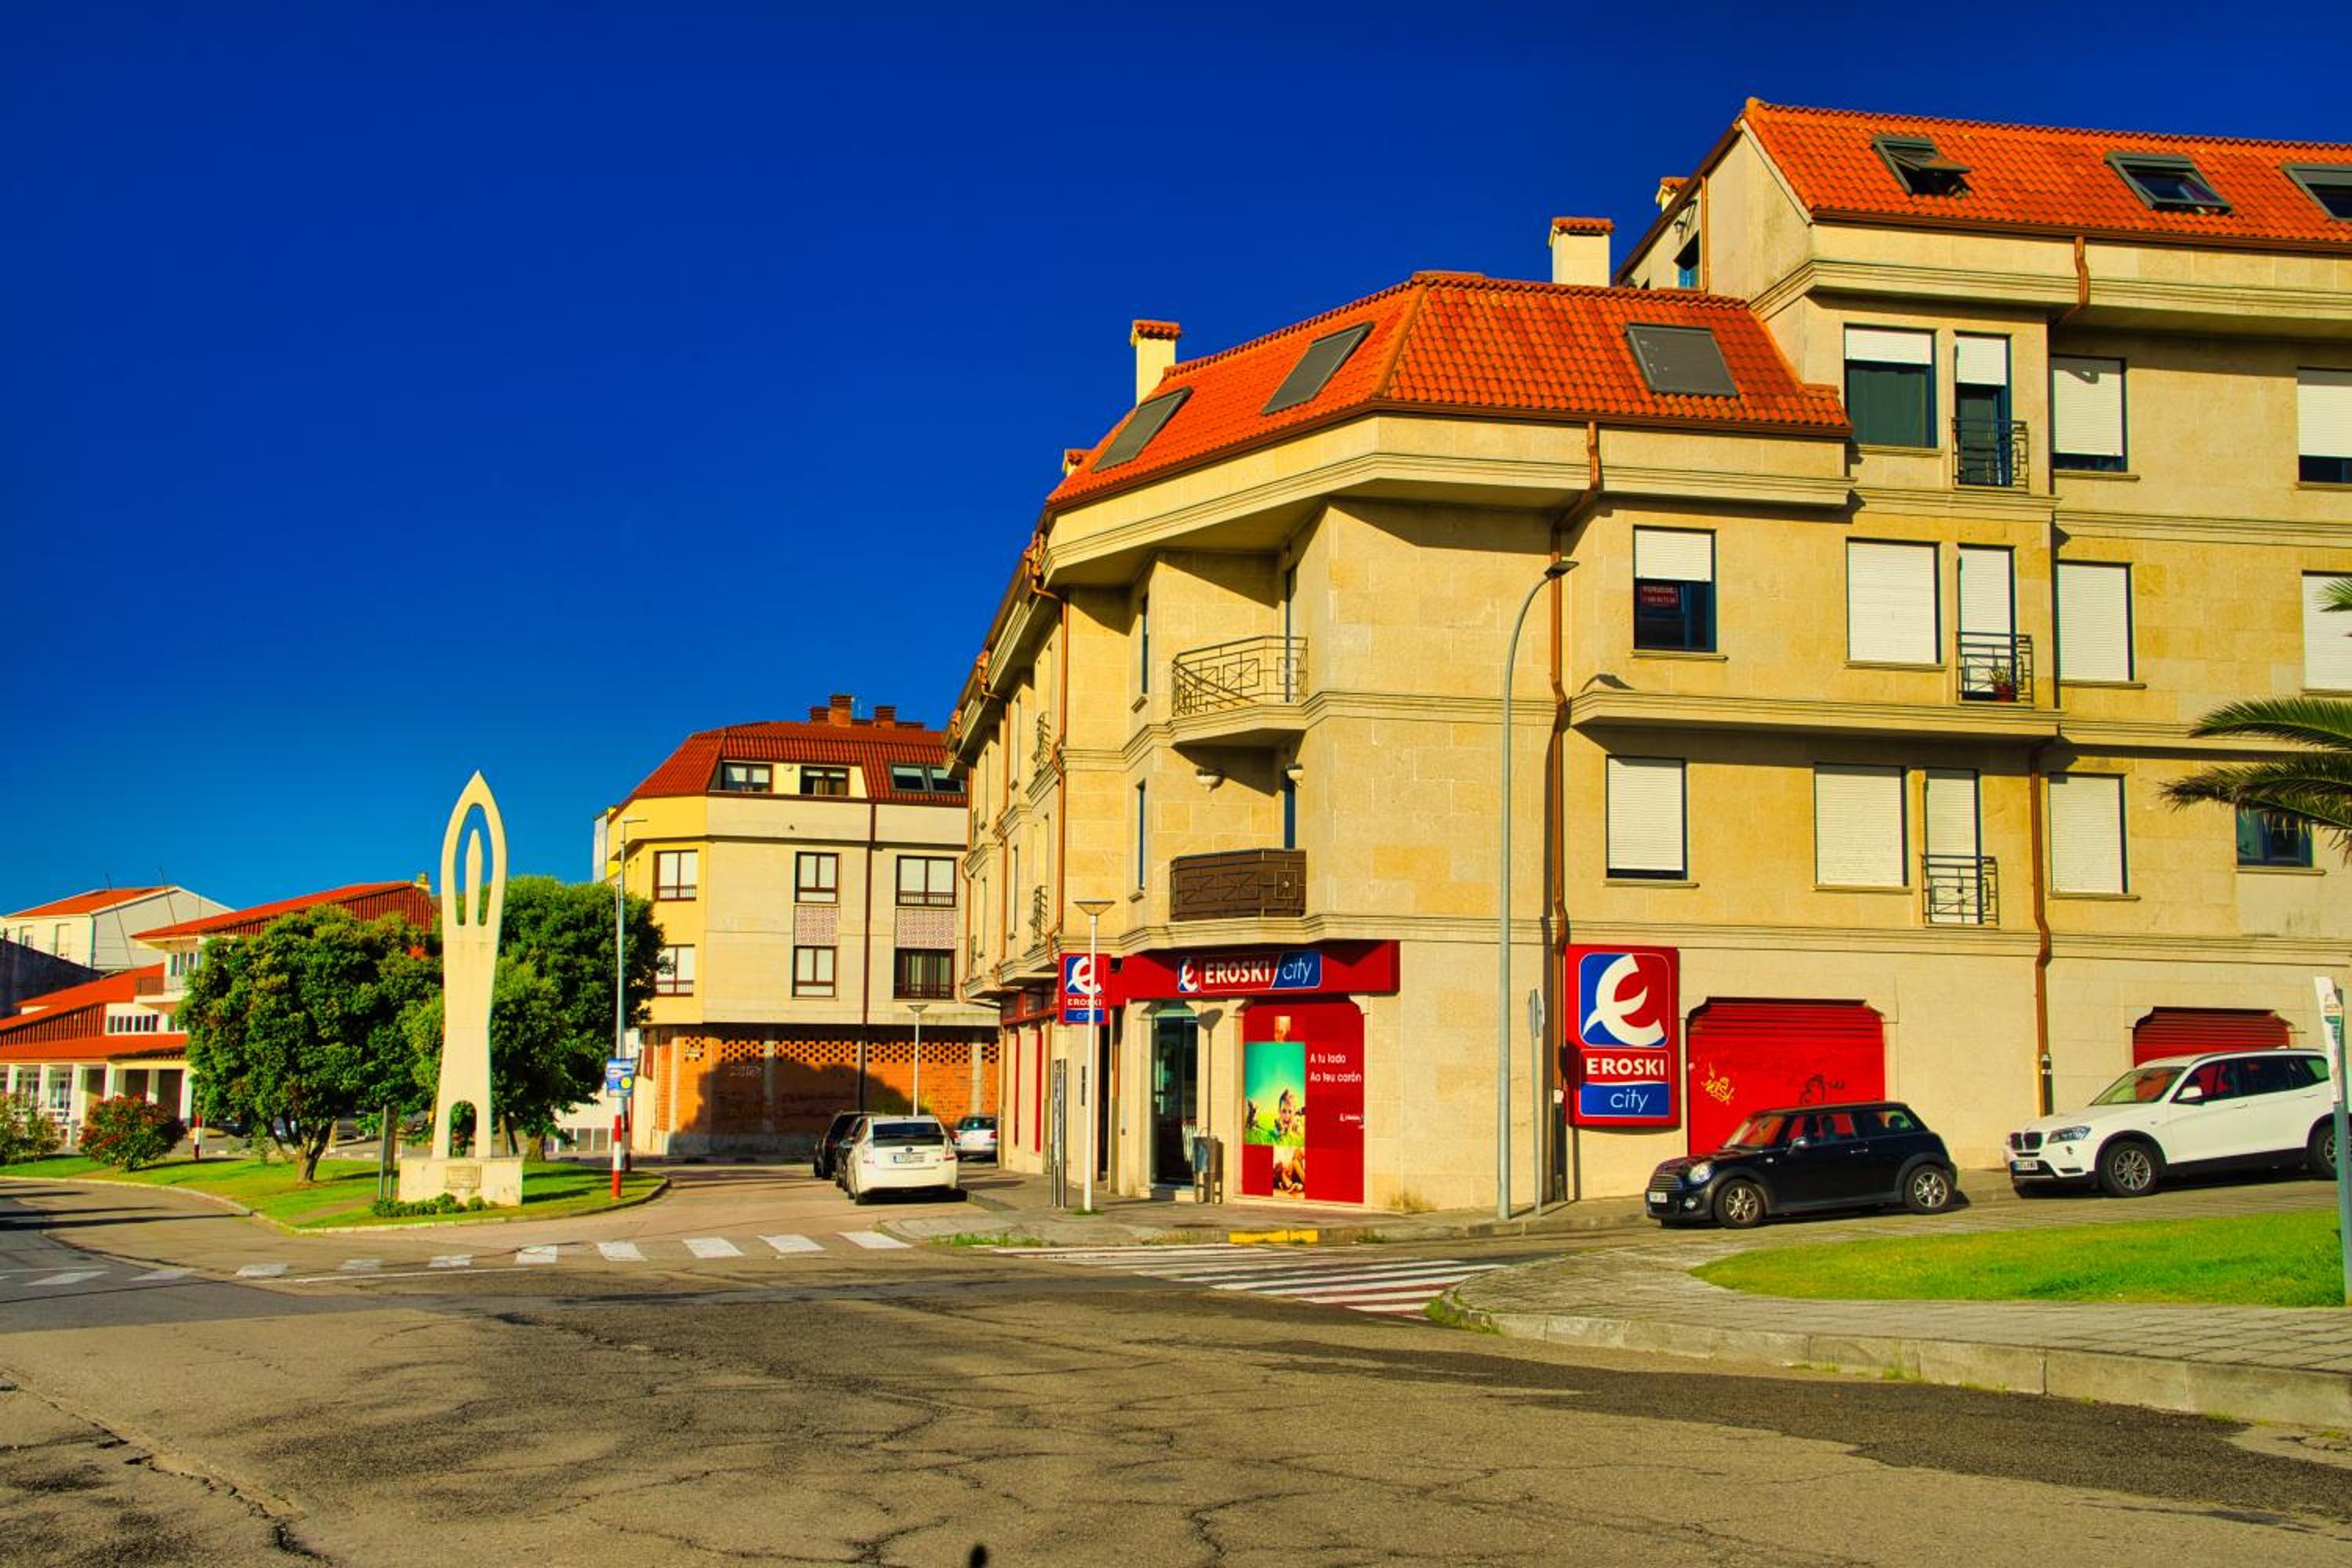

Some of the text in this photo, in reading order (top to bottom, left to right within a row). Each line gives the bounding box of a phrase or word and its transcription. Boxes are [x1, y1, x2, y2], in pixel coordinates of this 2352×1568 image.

[1204, 957, 1312, 985] EROSKI city
[1310, 1053, 1346, 1064] A tu lado
[1586, 1057, 1664, 1076] EROSKI
[1310, 1072, 1321, 1083] Ao
[1323, 1072, 1335, 1083] teu
[1610, 1087, 1650, 1113] city
